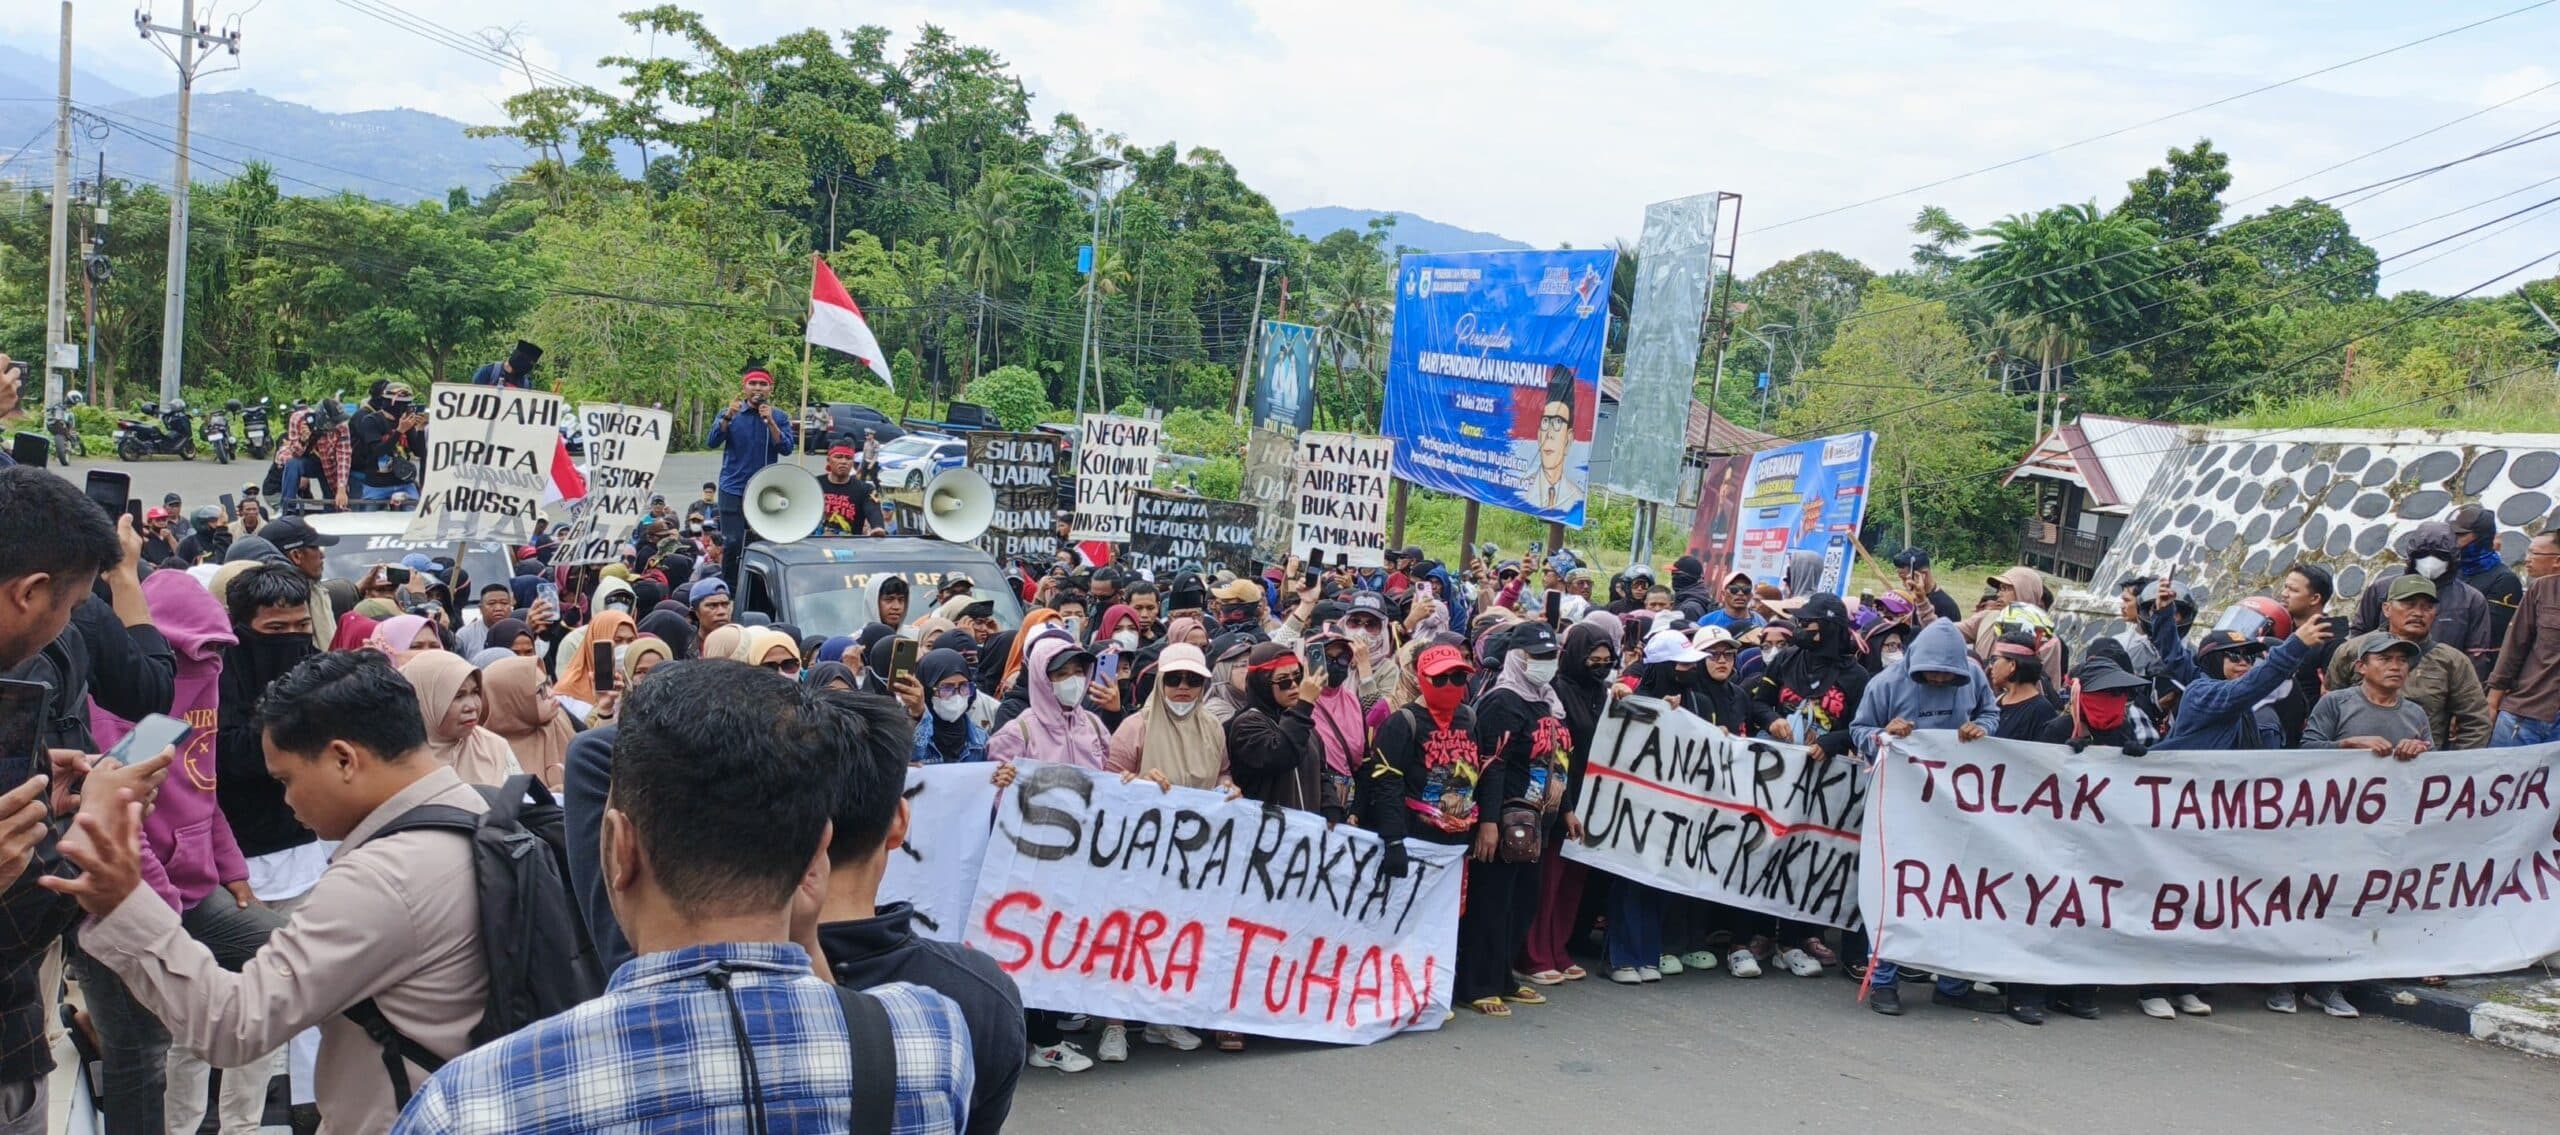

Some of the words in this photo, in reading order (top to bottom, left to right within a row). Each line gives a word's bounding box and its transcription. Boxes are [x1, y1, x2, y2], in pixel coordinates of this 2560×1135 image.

[1418, 351, 1439, 373] HARI
[1439, 354, 1494, 382] PENDIDIKAN
[1494, 359, 1548, 388] NASIONAL
[436, 390, 559, 427] SUDAHI
[1455, 394, 1460, 408] 2
[1461, 395, 1475, 410] Mei
[1476, 397, 1494, 414] 2025
[1086, 419, 1158, 446] NEGARA
[432, 440, 539, 475] DERITA
[1306, 443, 1388, 471] TANAH
[419, 486, 537, 521] KAROSSA
[1138, 497, 1209, 518] KATANYA
[1302, 495, 1378, 523] BUKAN
[1169, 540, 1207, 559] ADA
[1215, 525, 1254, 547] KOK
[1298, 522, 1385, 550] TAMBANG
[1608, 698, 1736, 797] TANAH
[1908, 756, 2110, 824] TOLAK
[2134, 776, 2387, 830] TAMBANG
[2414, 765, 2550, 825] PASIR
[1584, 775, 1735, 875] UNTUK
[1000, 765, 1233, 890] SUARA
[1242, 803, 1443, 934] RAKYAT
[1893, 858, 2124, 929] RAKYAT
[2151, 873, 2339, 931] BUKAN
[2351, 849, 2560, 917] PREMAN
[984, 890, 1206, 993] SUARA
[1227, 917, 1435, 1027] TUHAN
